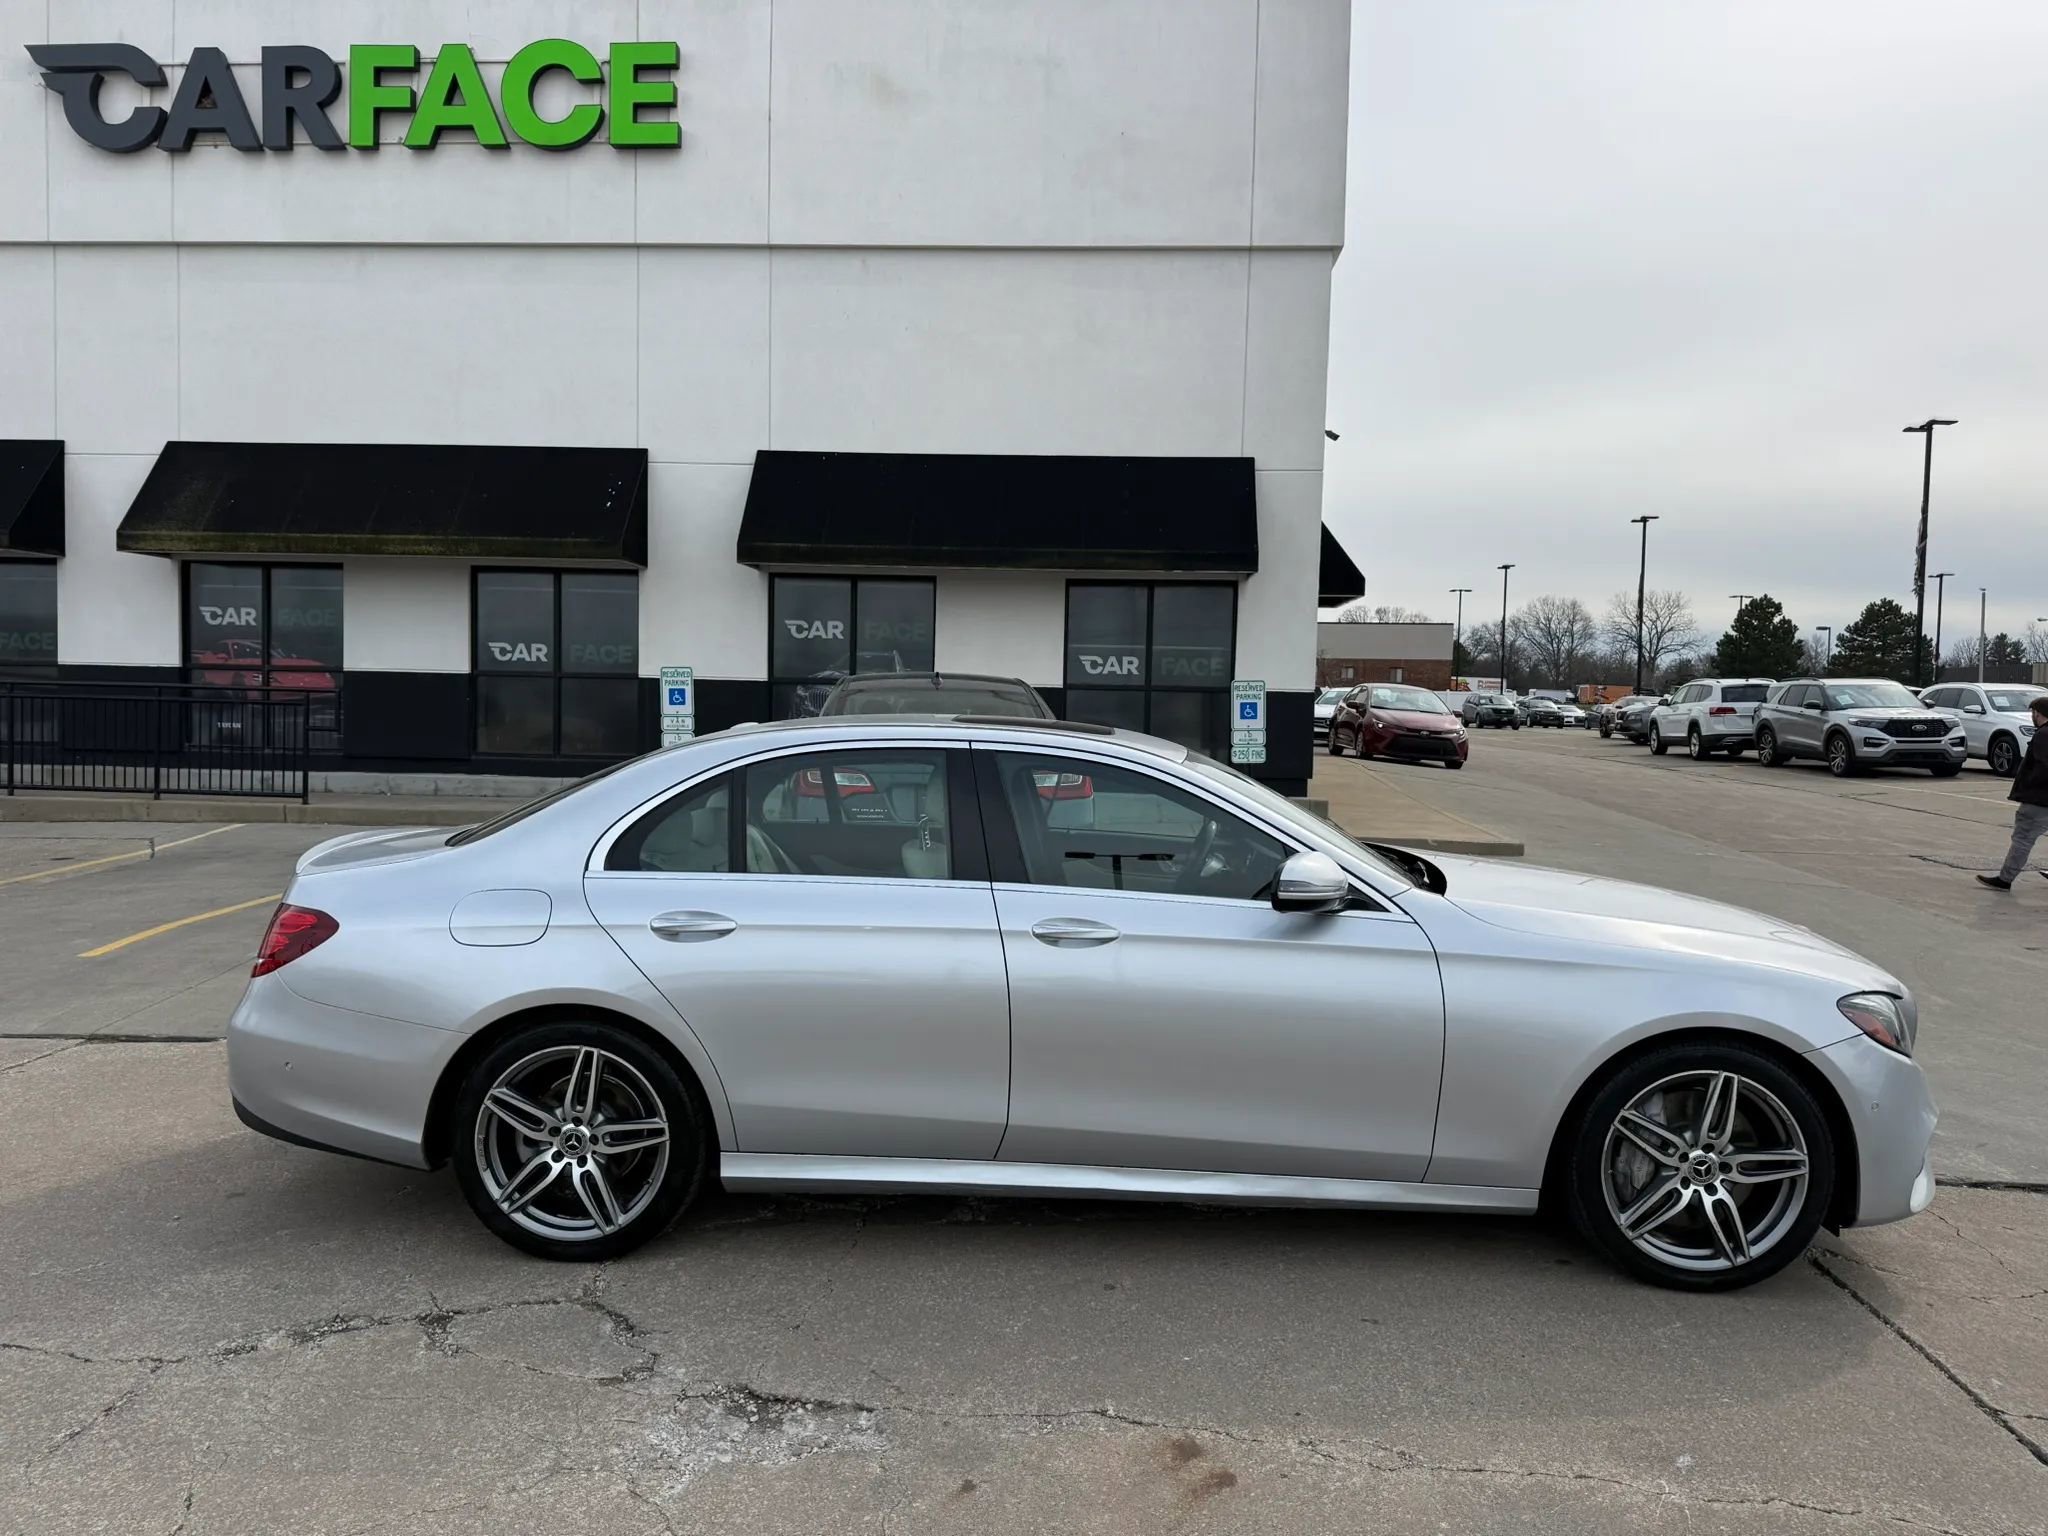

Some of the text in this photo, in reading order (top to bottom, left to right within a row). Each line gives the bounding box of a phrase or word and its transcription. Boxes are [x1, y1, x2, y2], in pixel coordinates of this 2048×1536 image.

[24, 38, 681, 153] CARFACE
[199, 606, 257, 626] CAR
[784, 620, 844, 639] CAR
[488, 642, 633, 664] CAR FACE
[662, 670, 691, 678] RESERVED
[1078, 655, 1225, 676] CAR FACE
[1234, 684, 1263, 692] RESERVED
[1232, 750, 1265, 760] $250 FINE
